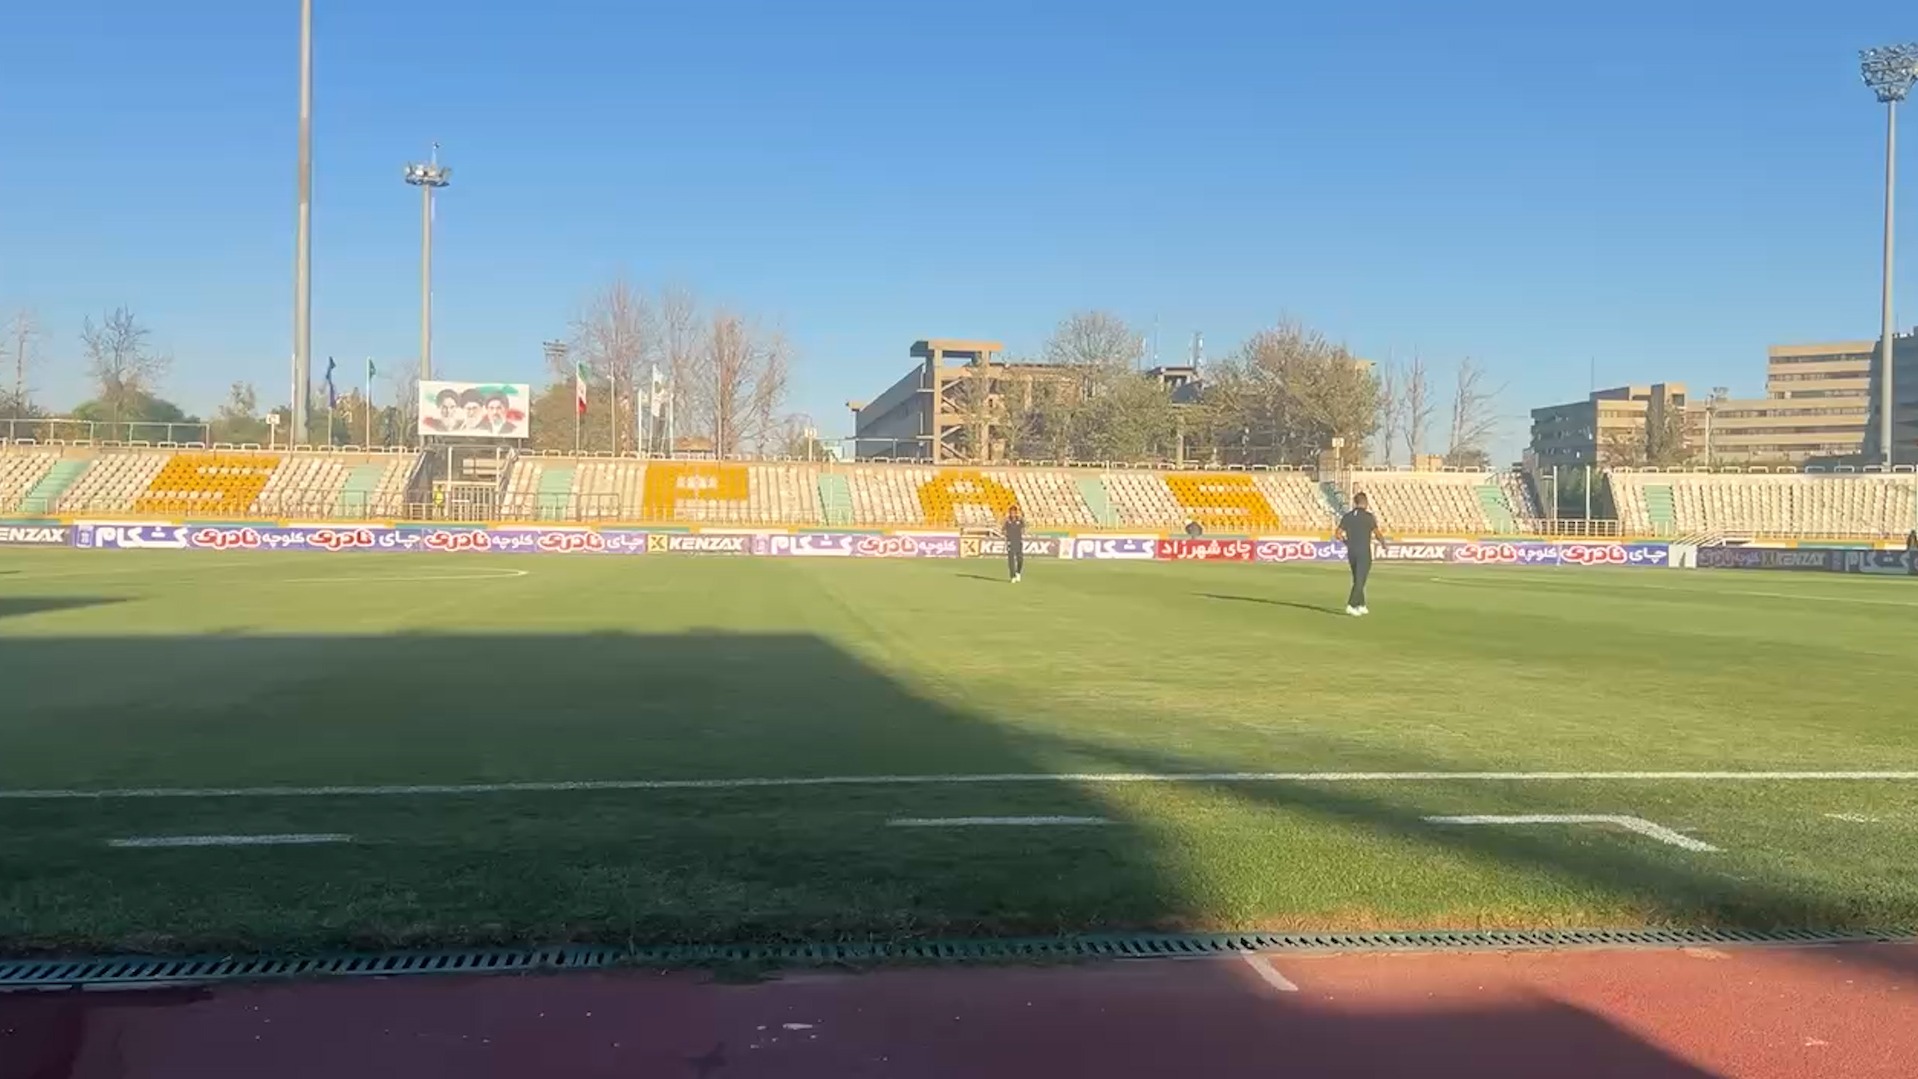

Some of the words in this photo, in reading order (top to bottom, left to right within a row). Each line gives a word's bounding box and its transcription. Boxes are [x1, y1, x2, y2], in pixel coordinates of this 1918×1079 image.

[0, 527, 64, 542] ENZAX
[379, 530, 421, 548] چای
[607, 534, 644, 551] چای
[669, 537, 744, 551] KENZAX
[1162, 540, 1220, 559] شهرزاد
[1223, 541, 1251, 559] چای
[1376, 545, 1446, 559] KENZAX
[1629, 547, 1667, 564] چای
